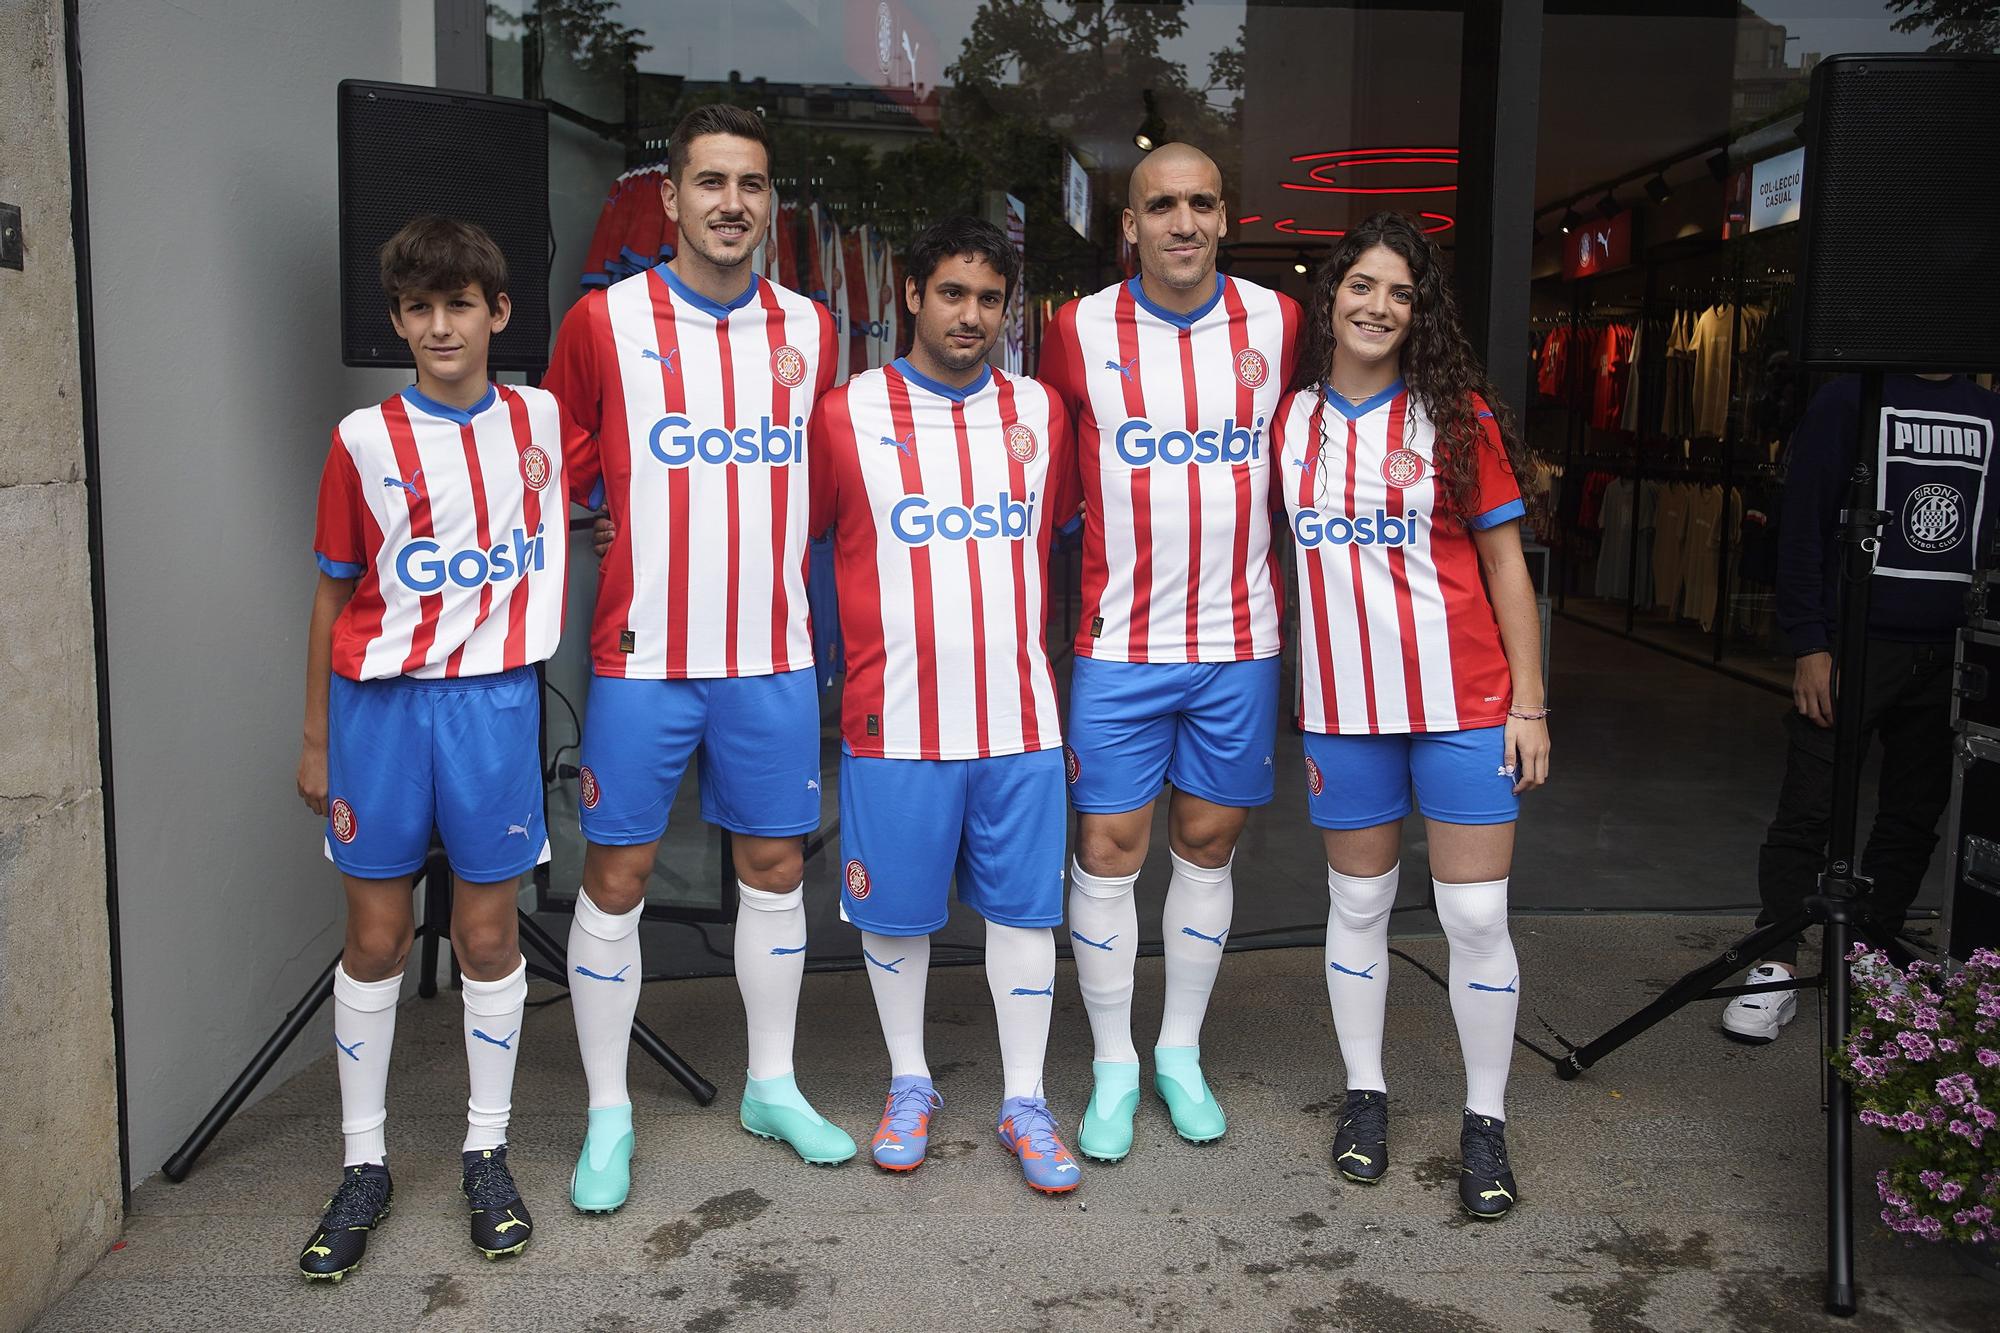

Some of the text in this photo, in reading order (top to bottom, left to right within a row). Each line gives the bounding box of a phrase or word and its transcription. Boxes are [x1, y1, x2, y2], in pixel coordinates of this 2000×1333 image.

[1765, 191, 1792, 208] CASUAL
[776, 348, 801, 359] GIRONA
[1240, 352, 1261, 361] GIRONA
[649, 415, 804, 466] Gosbi
[1115, 416, 1265, 466] Gosbi
[1894, 421, 1982, 459] PUMA
[1390, 452, 1417, 462] GIRONA
[1914, 486, 1959, 504] GIRONA
[890, 491, 1036, 544] Gosbi
[1294, 509, 1418, 547] Gosbi
[1908, 534, 1957, 549] FUTBOL CLUB
[395, 522, 545, 592] Gosbi
